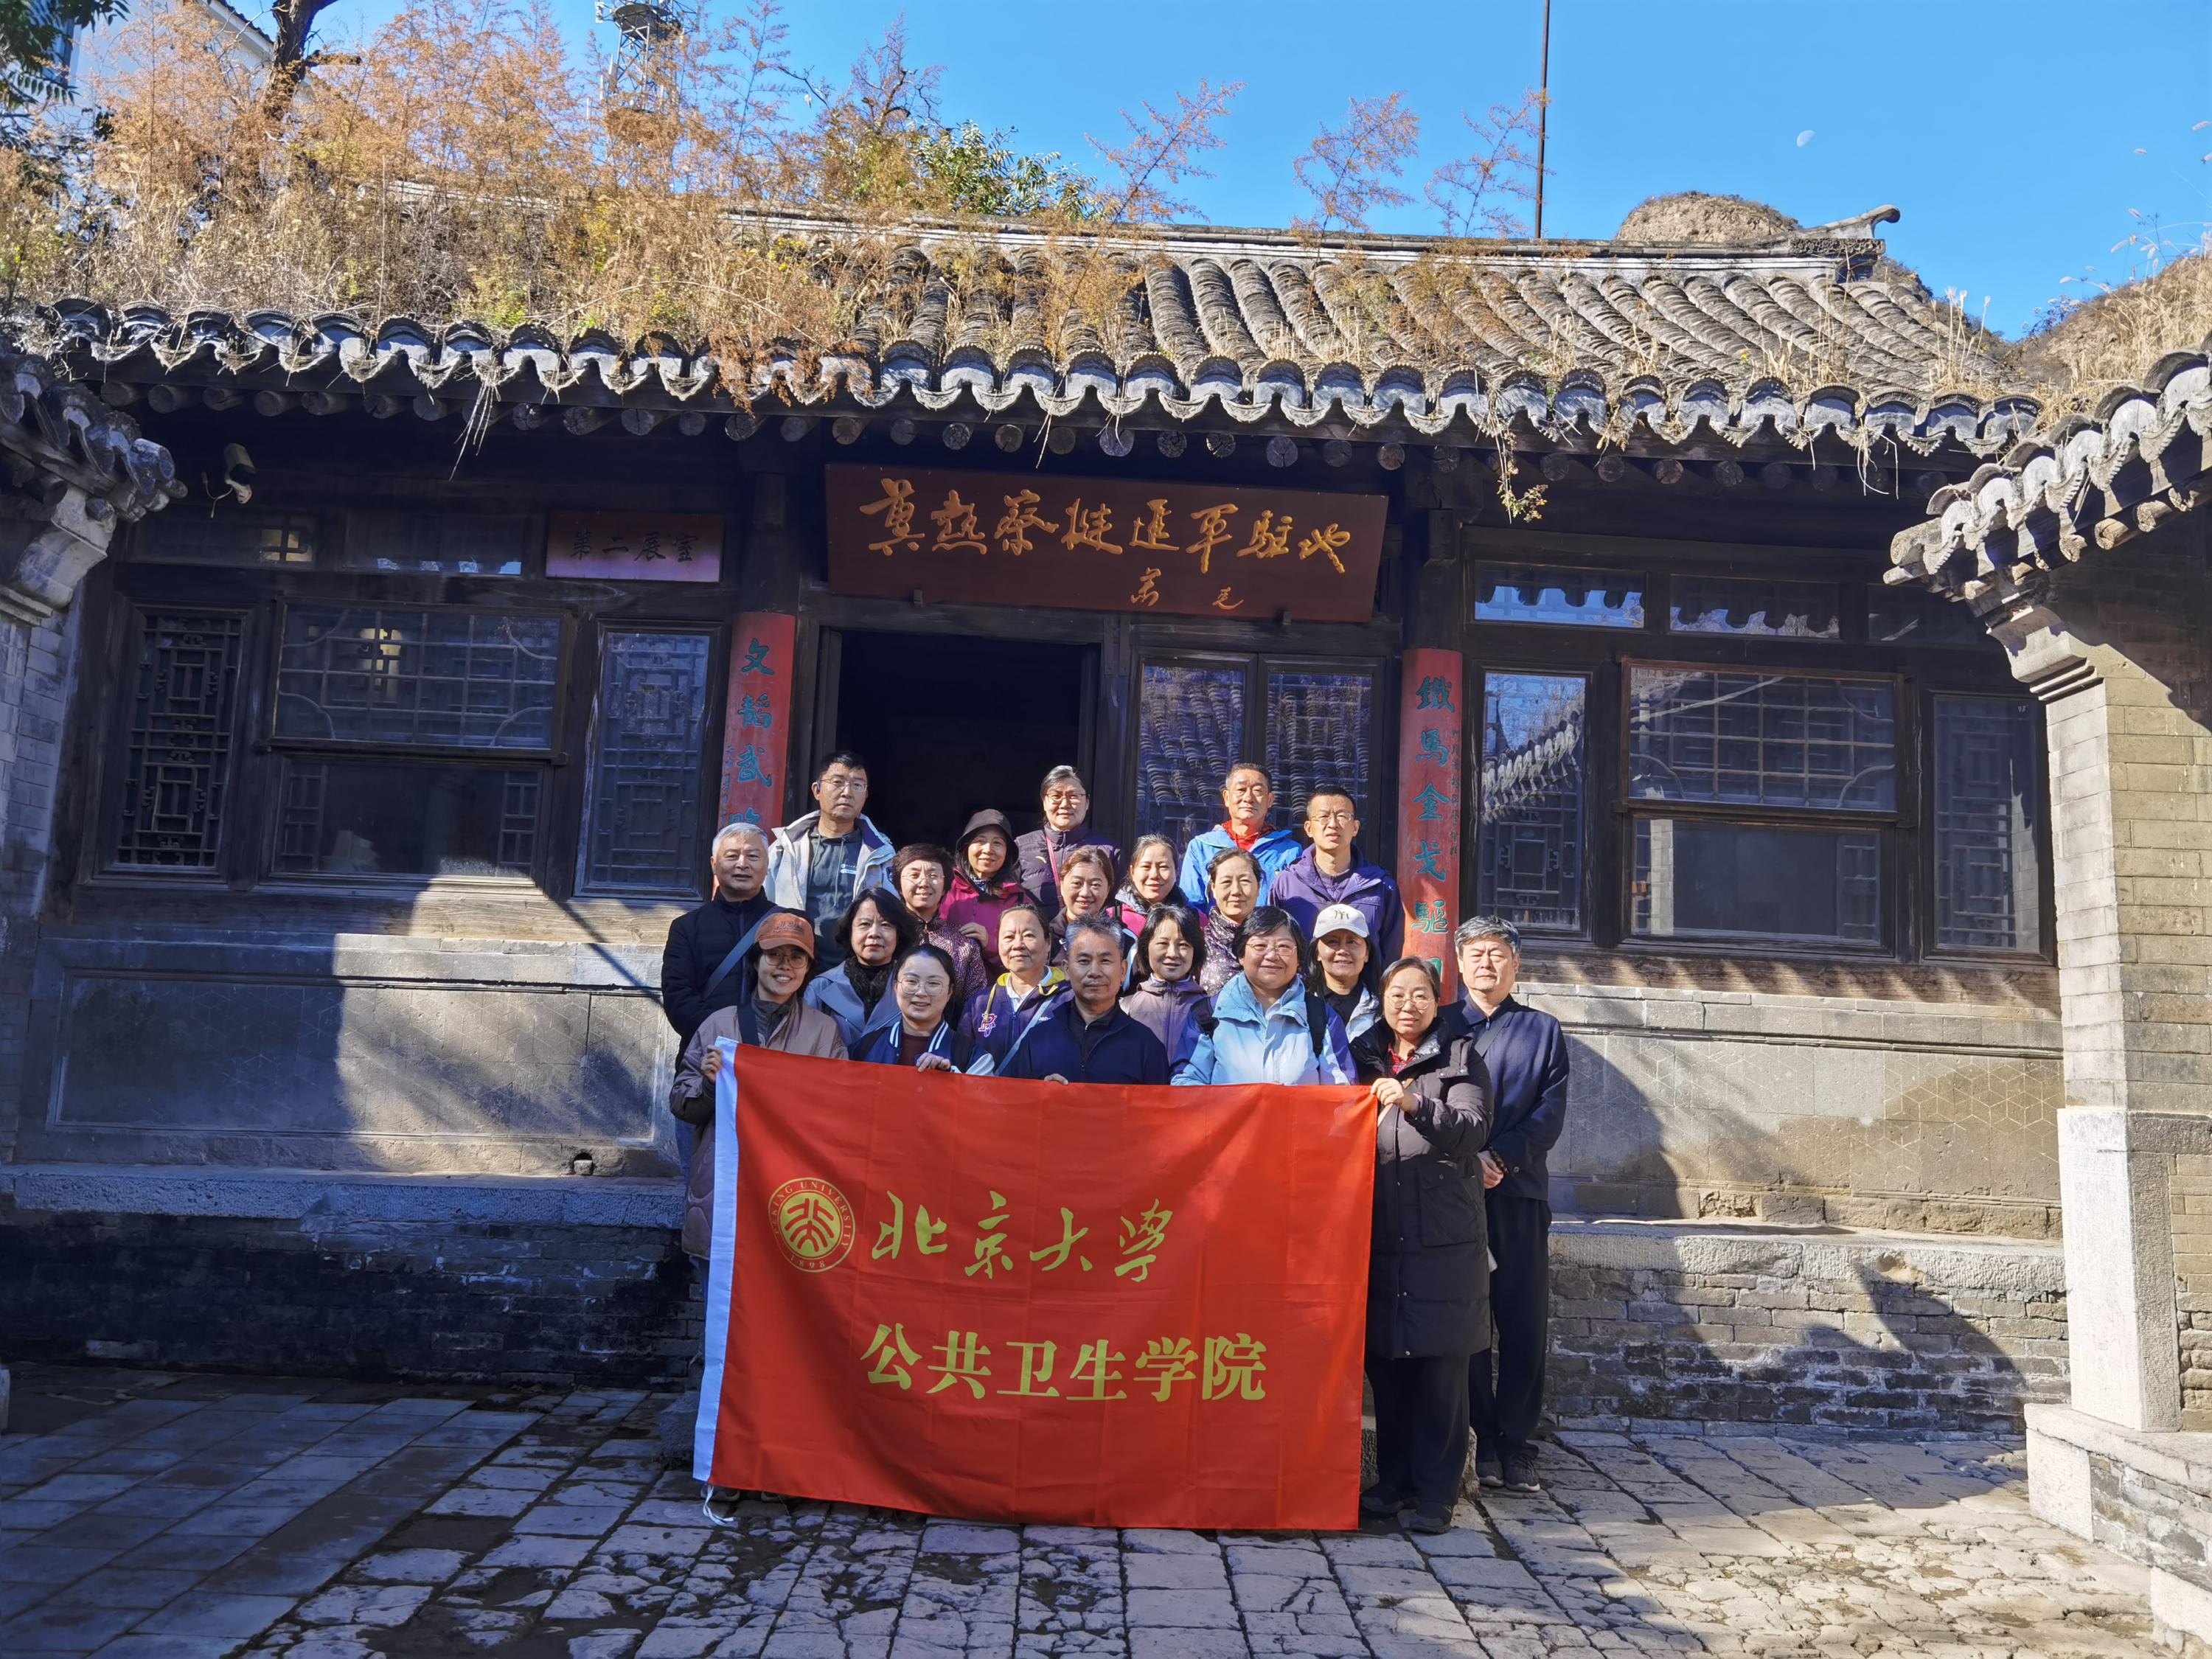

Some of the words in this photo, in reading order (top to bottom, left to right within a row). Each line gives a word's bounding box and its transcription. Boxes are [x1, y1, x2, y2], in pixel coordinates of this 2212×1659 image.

[569, 527, 699, 562] 第二展室
[1410, 675, 1455, 984] 鐵馬金戈驅
[800, 1181, 852, 1248] UNIVERSITY
[790, 1254, 825, 1269] 1898
[860, 1323, 1266, 1402] 公共卫生学院
